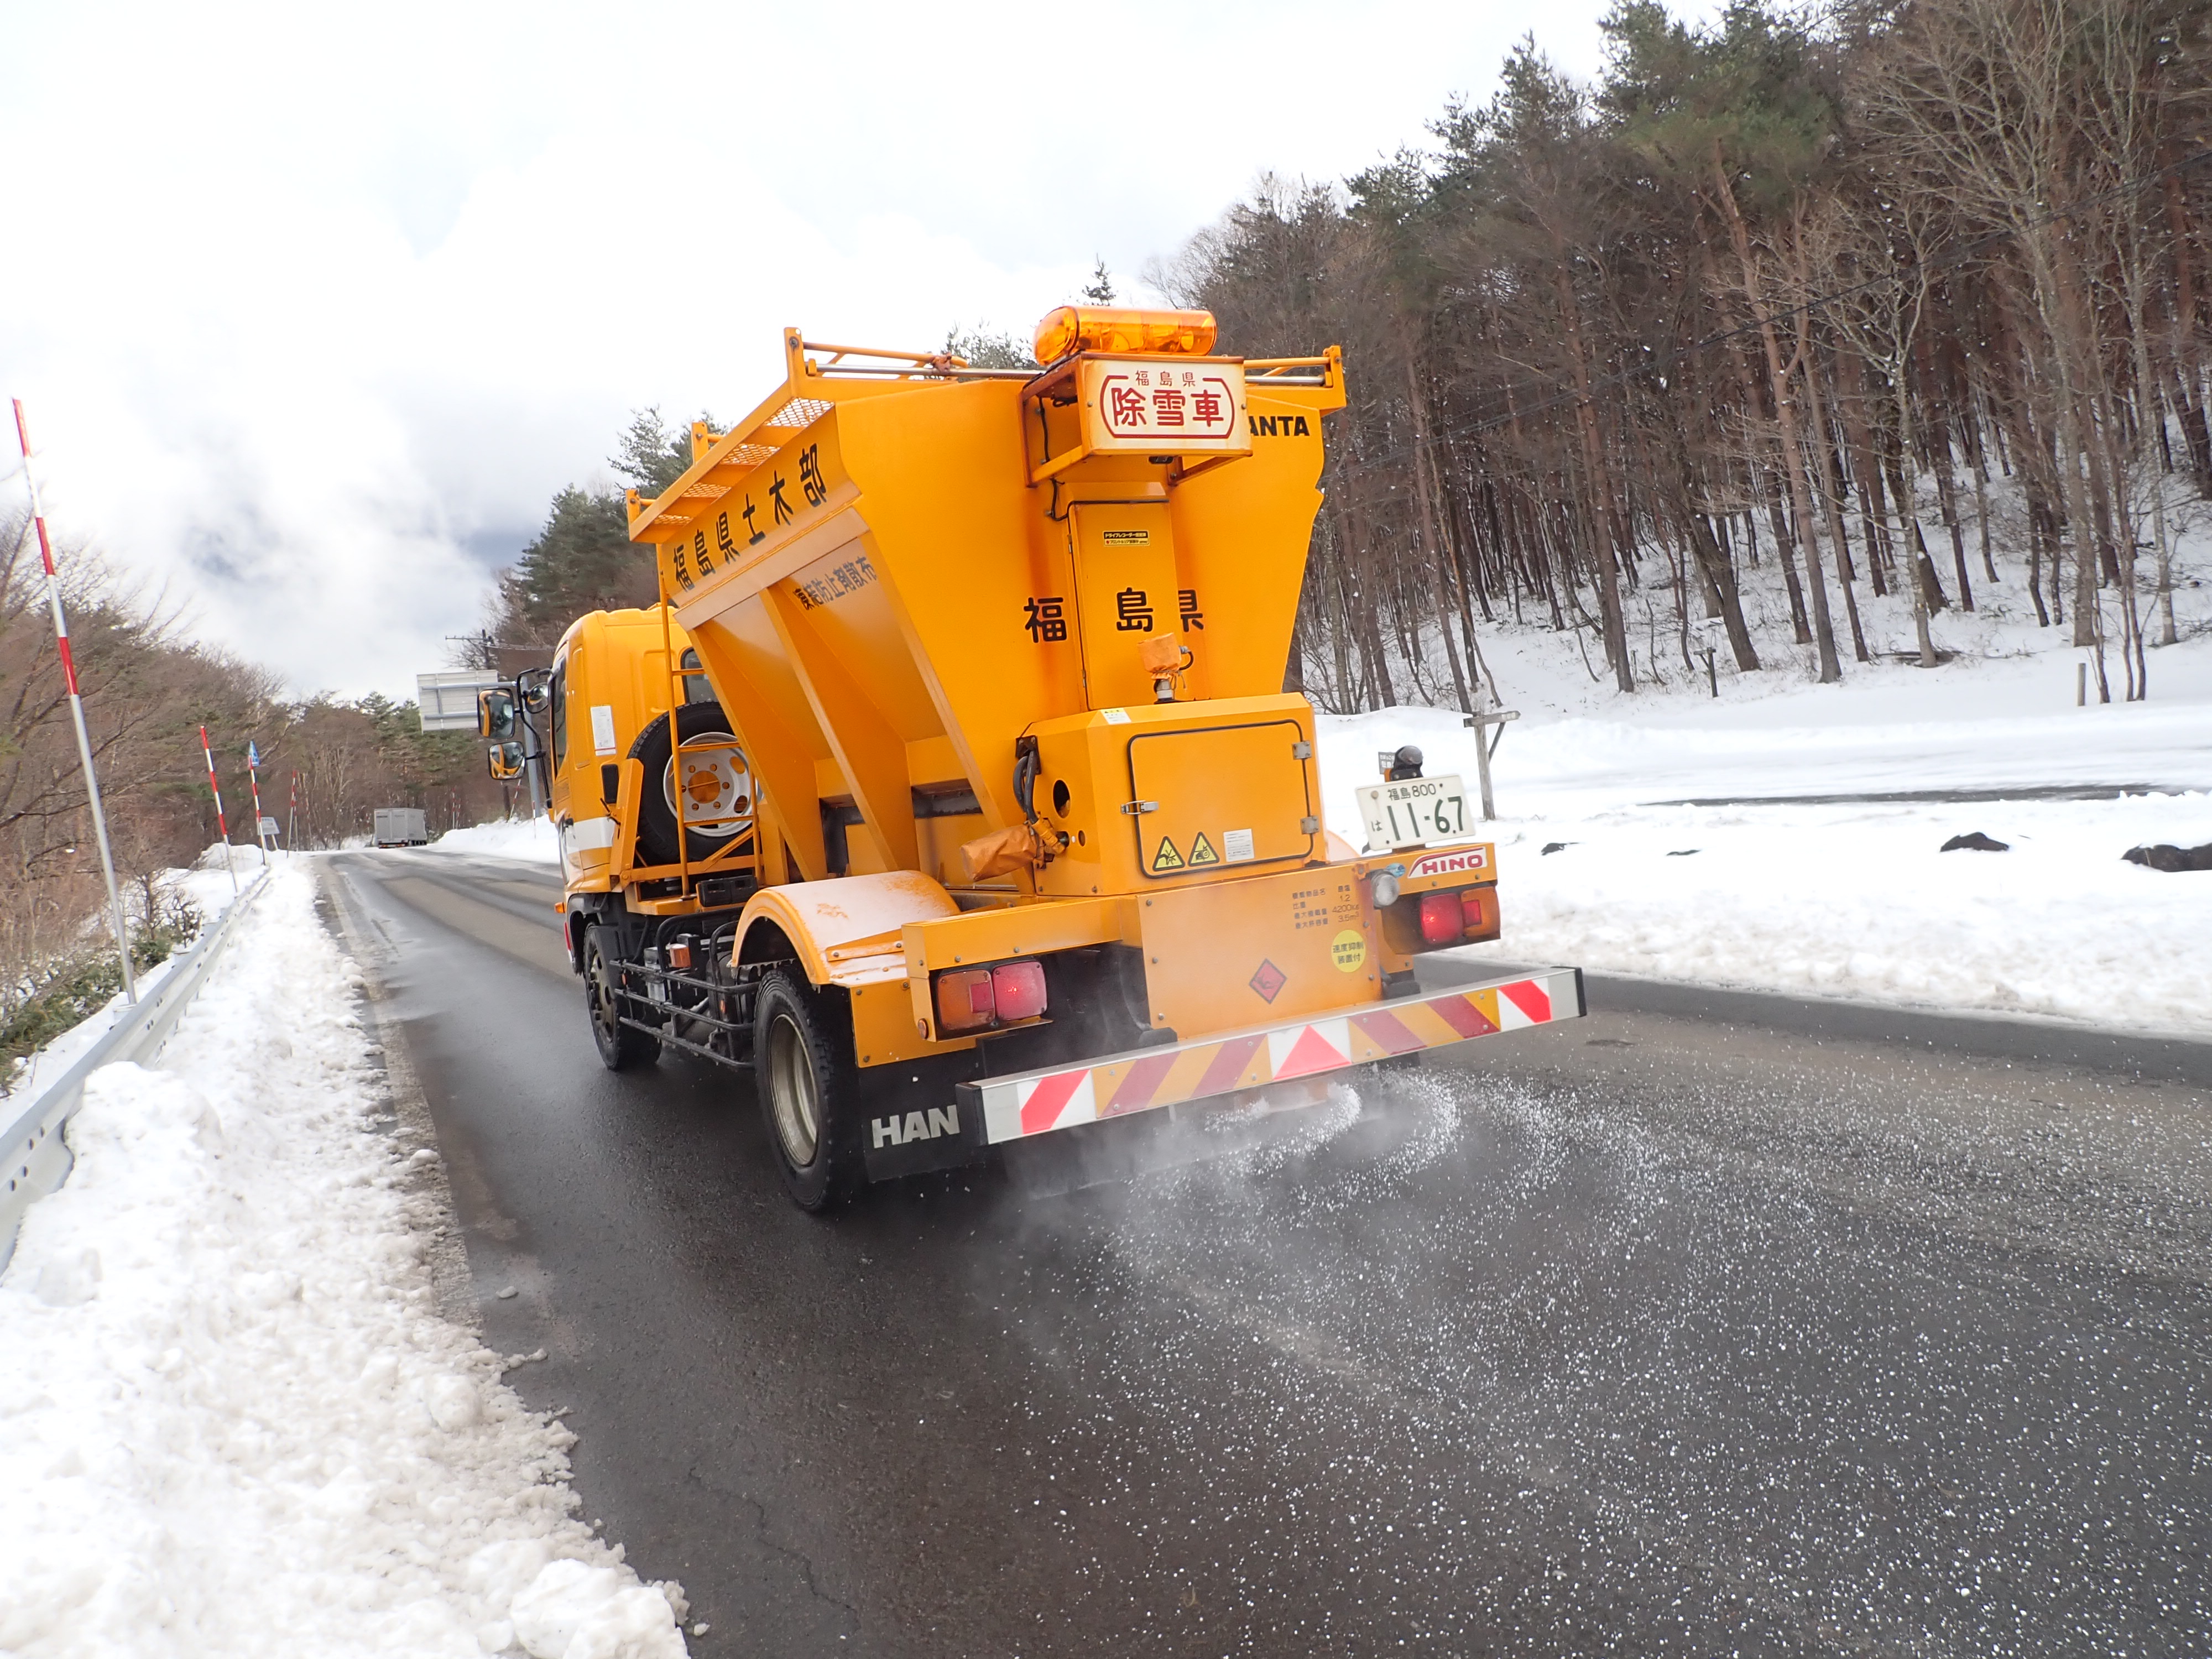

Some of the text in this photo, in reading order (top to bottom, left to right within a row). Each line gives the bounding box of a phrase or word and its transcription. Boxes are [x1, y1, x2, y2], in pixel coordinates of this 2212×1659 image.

[1135, 370, 1196, 387] 福島県
[1111, 388, 1224, 427] 除雪車
[674, 443, 827, 592] 福島県土木部
[1371, 796, 1463, 841] は 11-67
[1422, 854, 1483, 875] HINO
[872, 1104, 960, 1148] HAN
